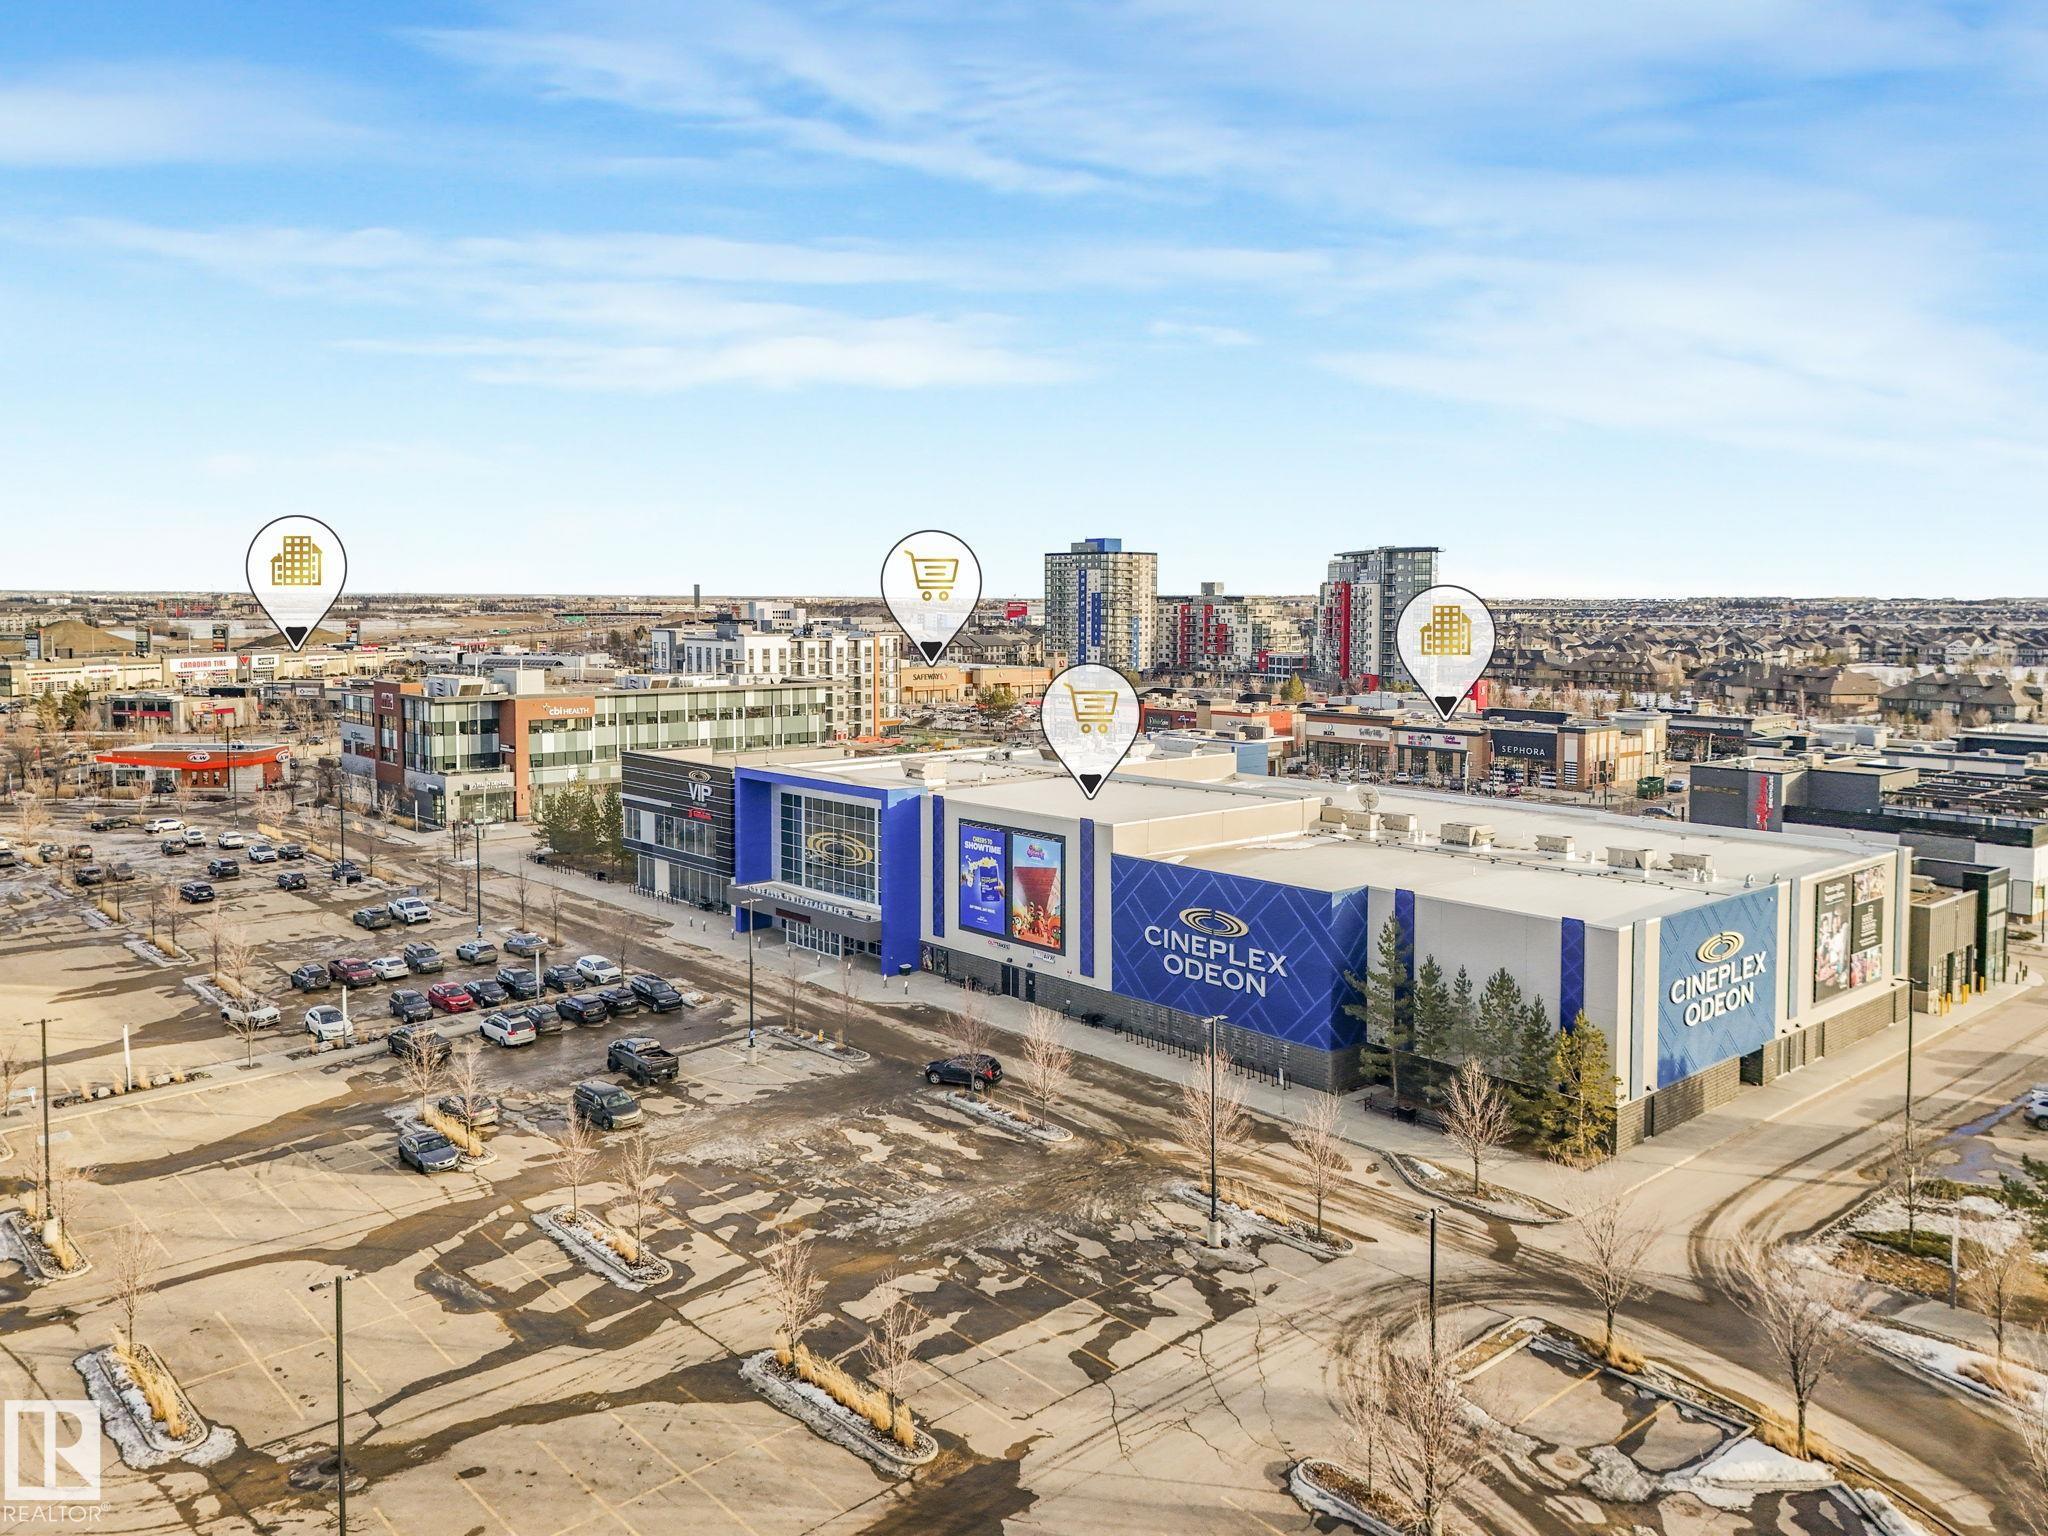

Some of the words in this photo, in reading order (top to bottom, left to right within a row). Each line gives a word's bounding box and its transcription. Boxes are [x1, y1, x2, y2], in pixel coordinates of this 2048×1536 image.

[180, 660, 212, 669] CANADIAN
[213, 659, 227, 667] TIRE
[912, 673, 940, 681] SAFEWAY
[548, 706, 562, 715] cbi
[563, 707, 590, 715] HEALTH
[1501, 745, 1546, 756] SEPHORA
[688, 782, 712, 803] VIP
[964, 841, 1002, 855] SHOWTIME
[1144, 925, 1289, 978] CINEPLEX
[1163, 954, 1267, 998] ODEON
[1670, 951, 1767, 1005] CINEPLEX
[1683, 982, 1754, 1028] ODEON
